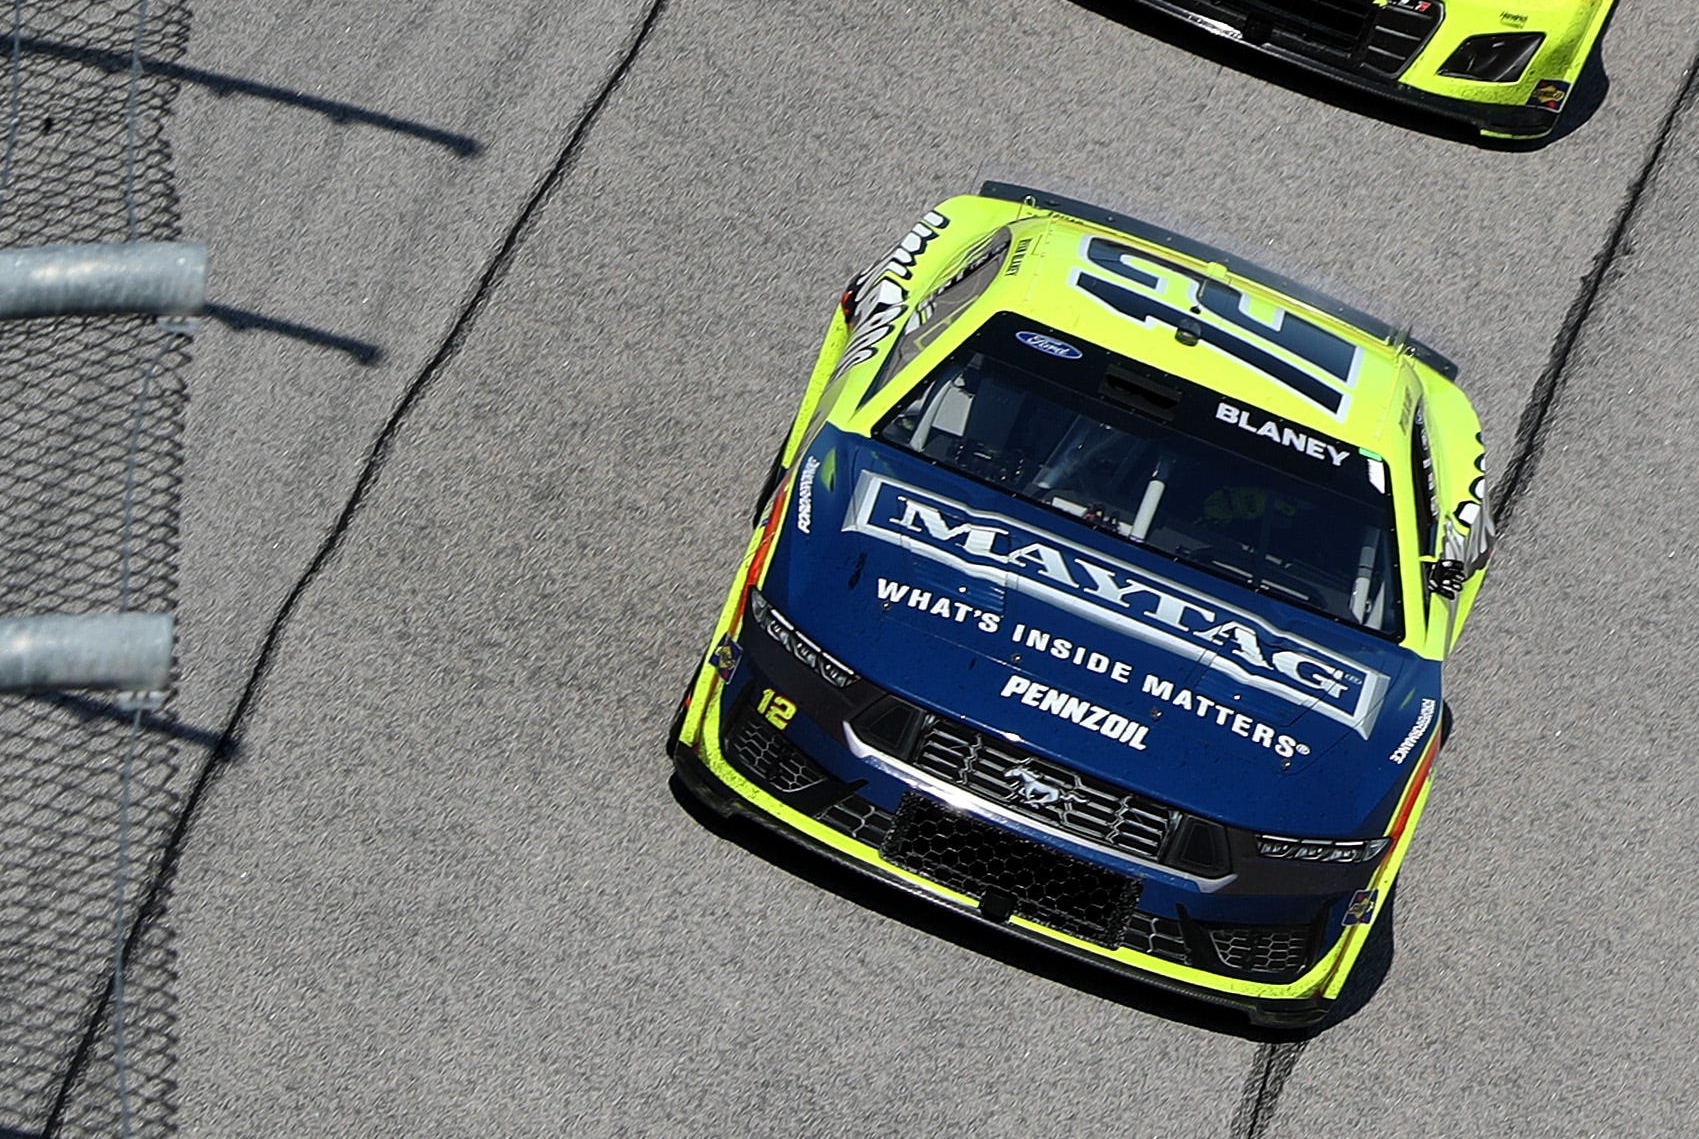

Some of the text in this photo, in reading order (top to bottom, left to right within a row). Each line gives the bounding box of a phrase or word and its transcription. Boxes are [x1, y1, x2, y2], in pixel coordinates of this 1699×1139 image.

[1023, 333, 1075, 358] Ford
[1067, 234, 1364, 423] 12
[1215, 401, 1350, 467] BLANEY
[877, 577, 1002, 633] WHAT'S
[1011, 623, 1132, 684] INSIDE
[756, 687, 798, 731] 12
[1000, 673, 1150, 752] PENNZOIL
